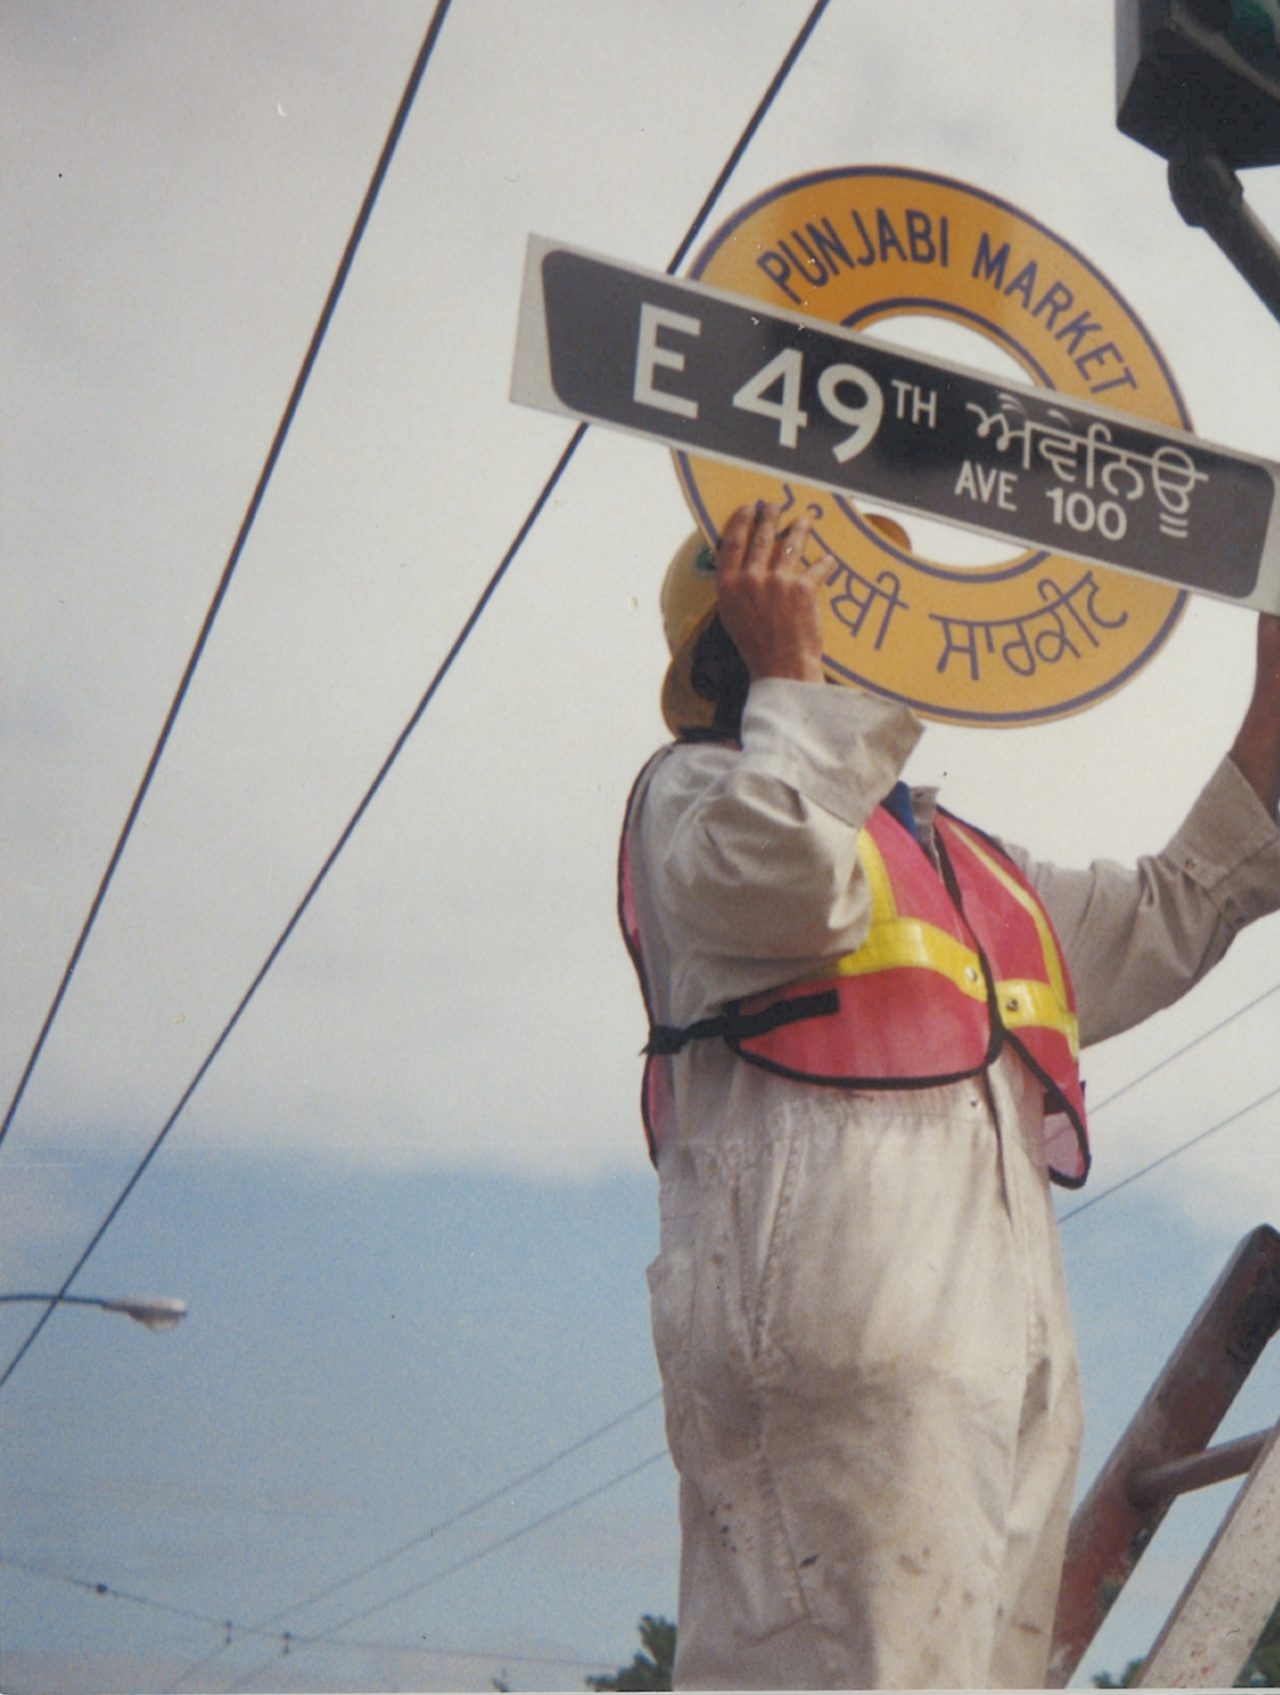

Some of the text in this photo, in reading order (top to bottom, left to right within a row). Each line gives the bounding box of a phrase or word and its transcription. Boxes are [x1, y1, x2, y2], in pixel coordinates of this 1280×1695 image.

[755, 207, 1139, 395] PUNJABI MARKET
[633, 302, 701, 420] E
[954, 460, 1128, 541] AVE 100
